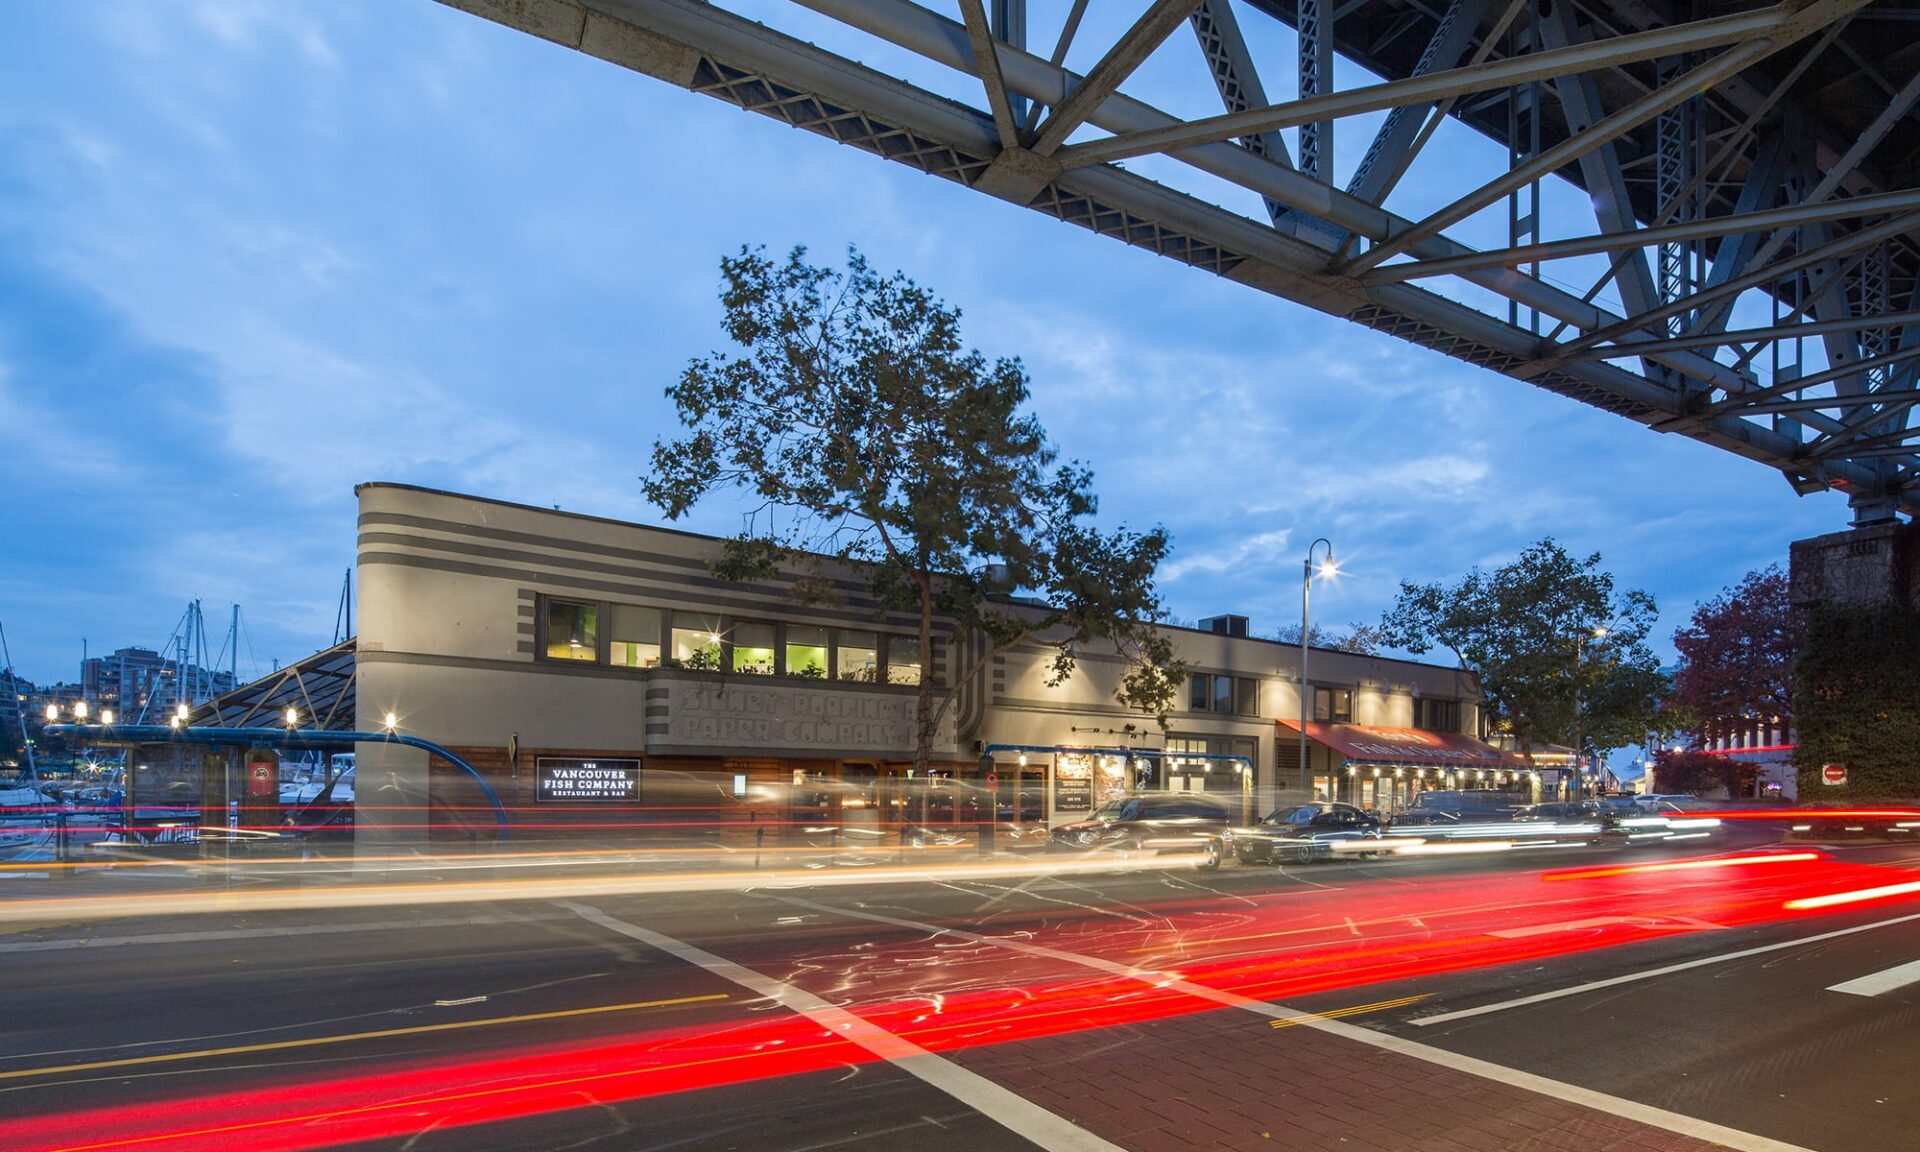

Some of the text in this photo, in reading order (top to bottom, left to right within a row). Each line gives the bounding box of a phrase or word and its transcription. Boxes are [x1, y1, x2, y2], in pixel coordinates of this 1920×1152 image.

[683, 716, 771, 741] PAPER
[783, 720, 894, 746] COMPANY
[552, 769, 626, 780] VANCOUVER
[543, 780, 635, 790] FISH COMPANY
